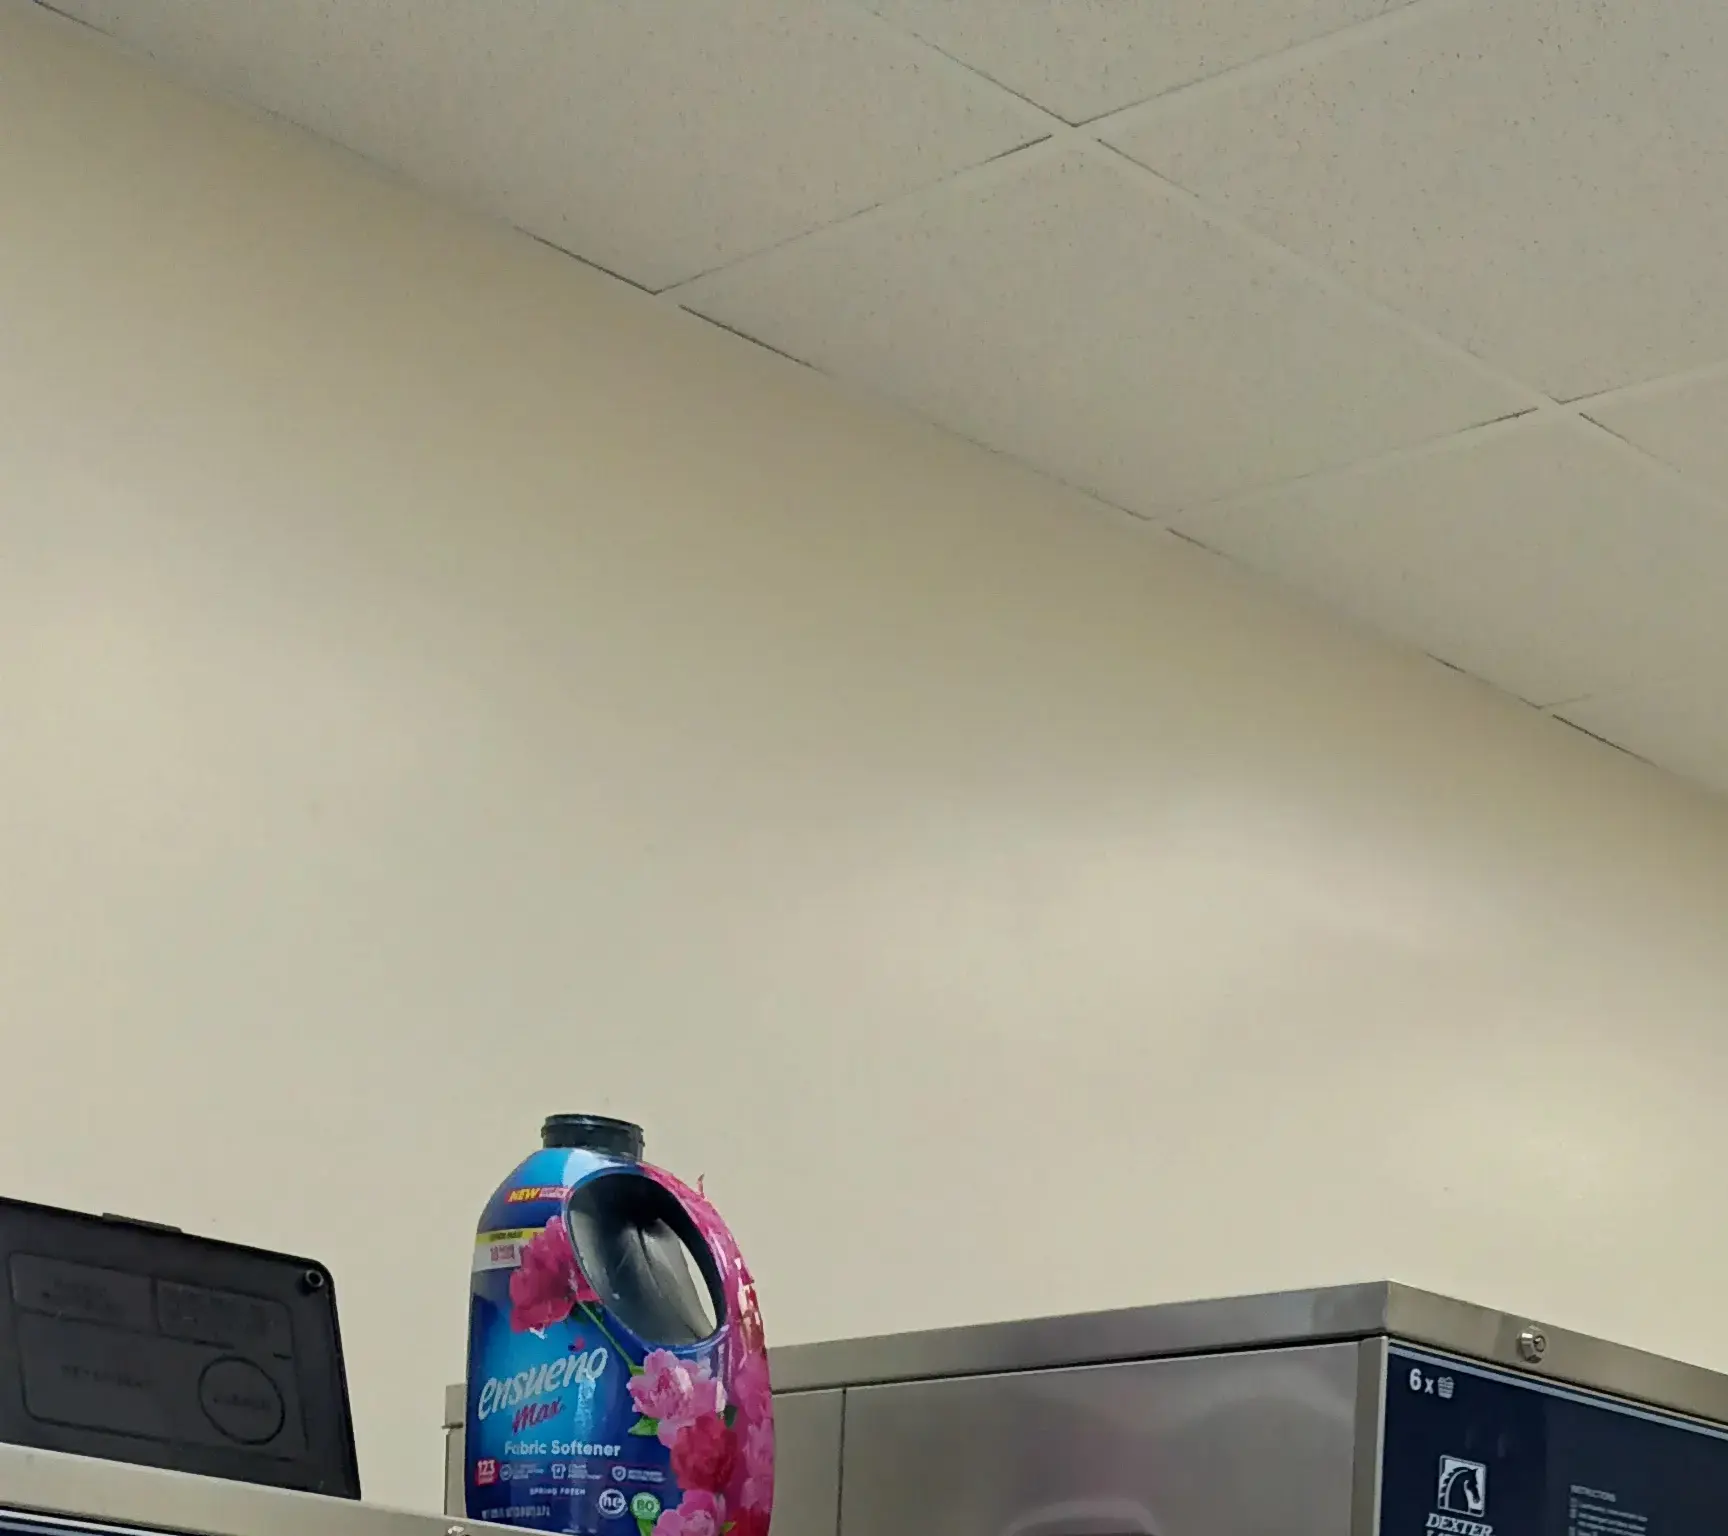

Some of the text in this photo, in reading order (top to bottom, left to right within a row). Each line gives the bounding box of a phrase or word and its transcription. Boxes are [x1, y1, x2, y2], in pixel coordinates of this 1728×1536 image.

[508, 1188, 541, 1202] NEW
[1409, 1368, 1421, 1391] 6
[512, 1396, 563, 1435] Max
[505, 1440, 621, 1457] Fabric Softener
